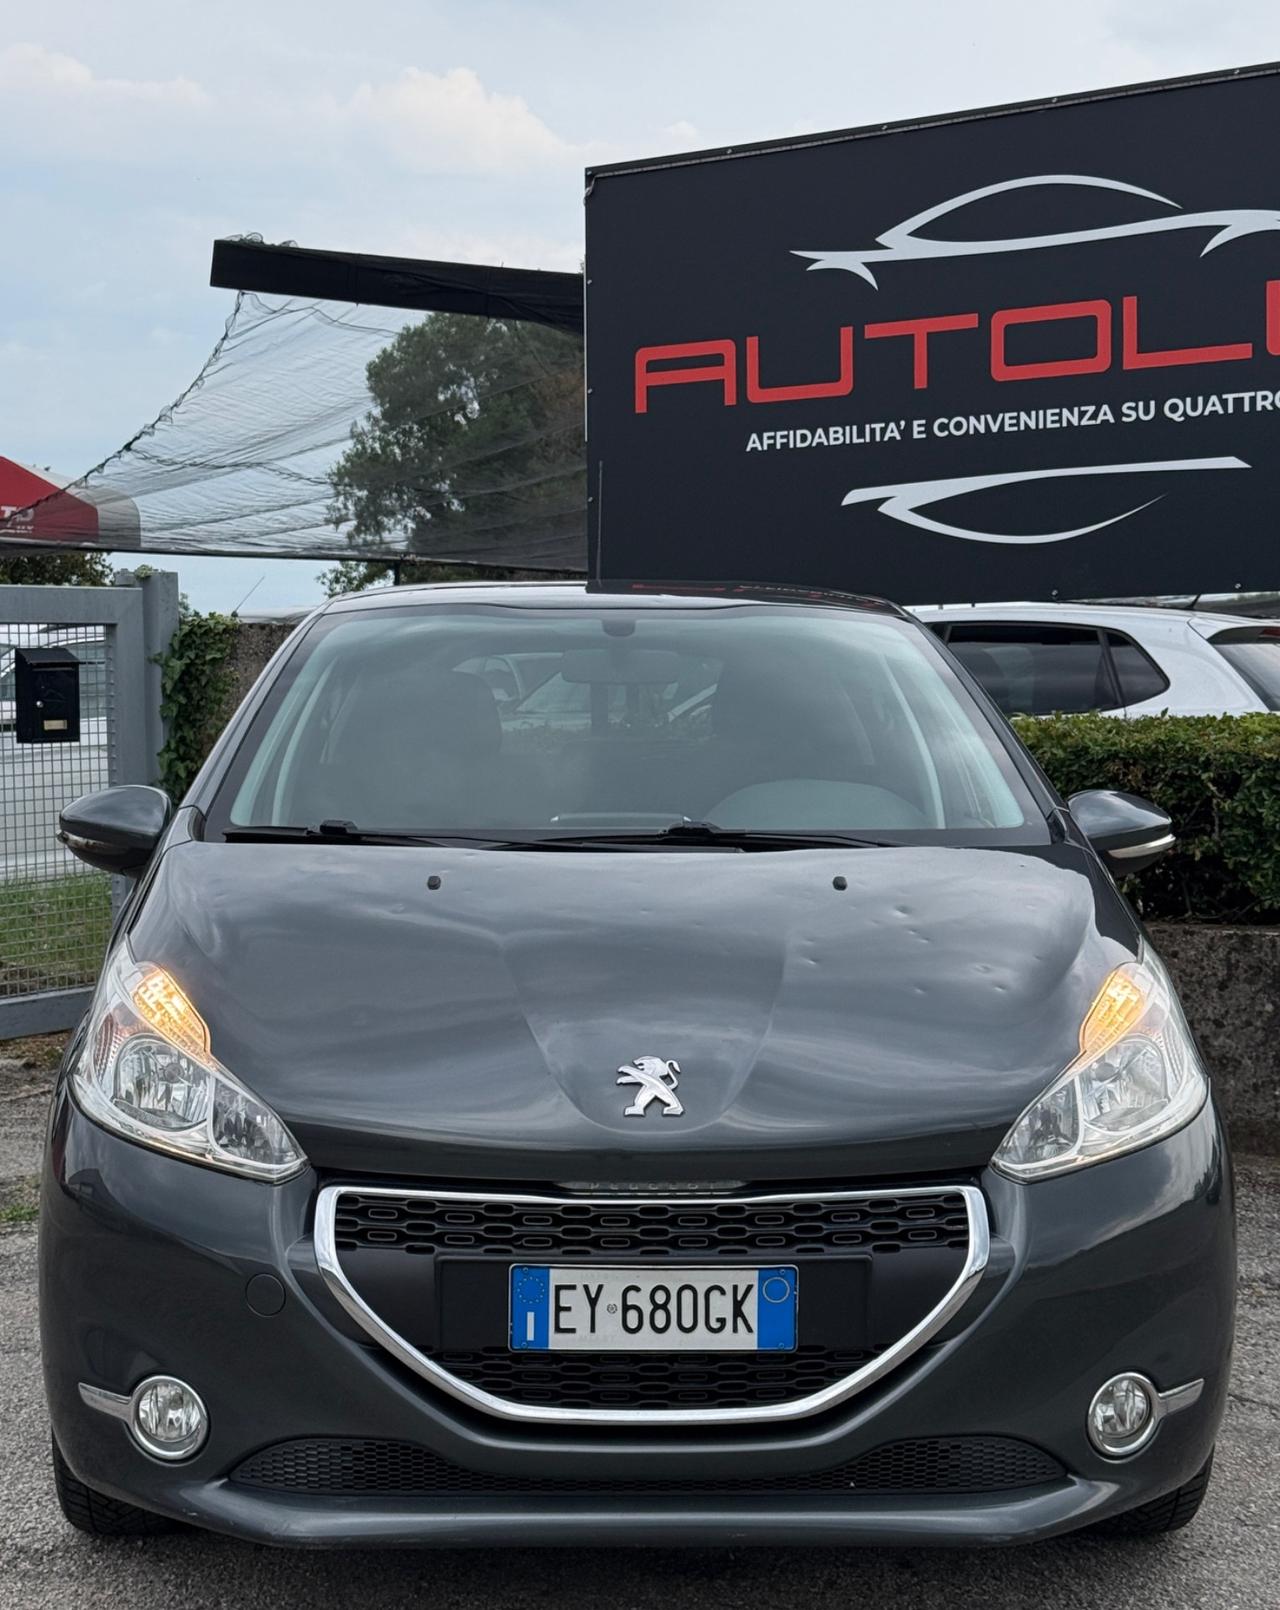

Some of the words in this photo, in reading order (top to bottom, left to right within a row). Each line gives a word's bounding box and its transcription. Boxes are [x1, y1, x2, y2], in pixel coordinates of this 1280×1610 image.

[635, 280, 1280, 413] AUTOL
[913, 420, 926, 438] E
[934, 405, 1114, 437] CONVENIENZA
[1122, 401, 1155, 422] SU
[1164, 391, 1280, 421] QUATTR
[622, 1284, 753, 1334] 680GK
